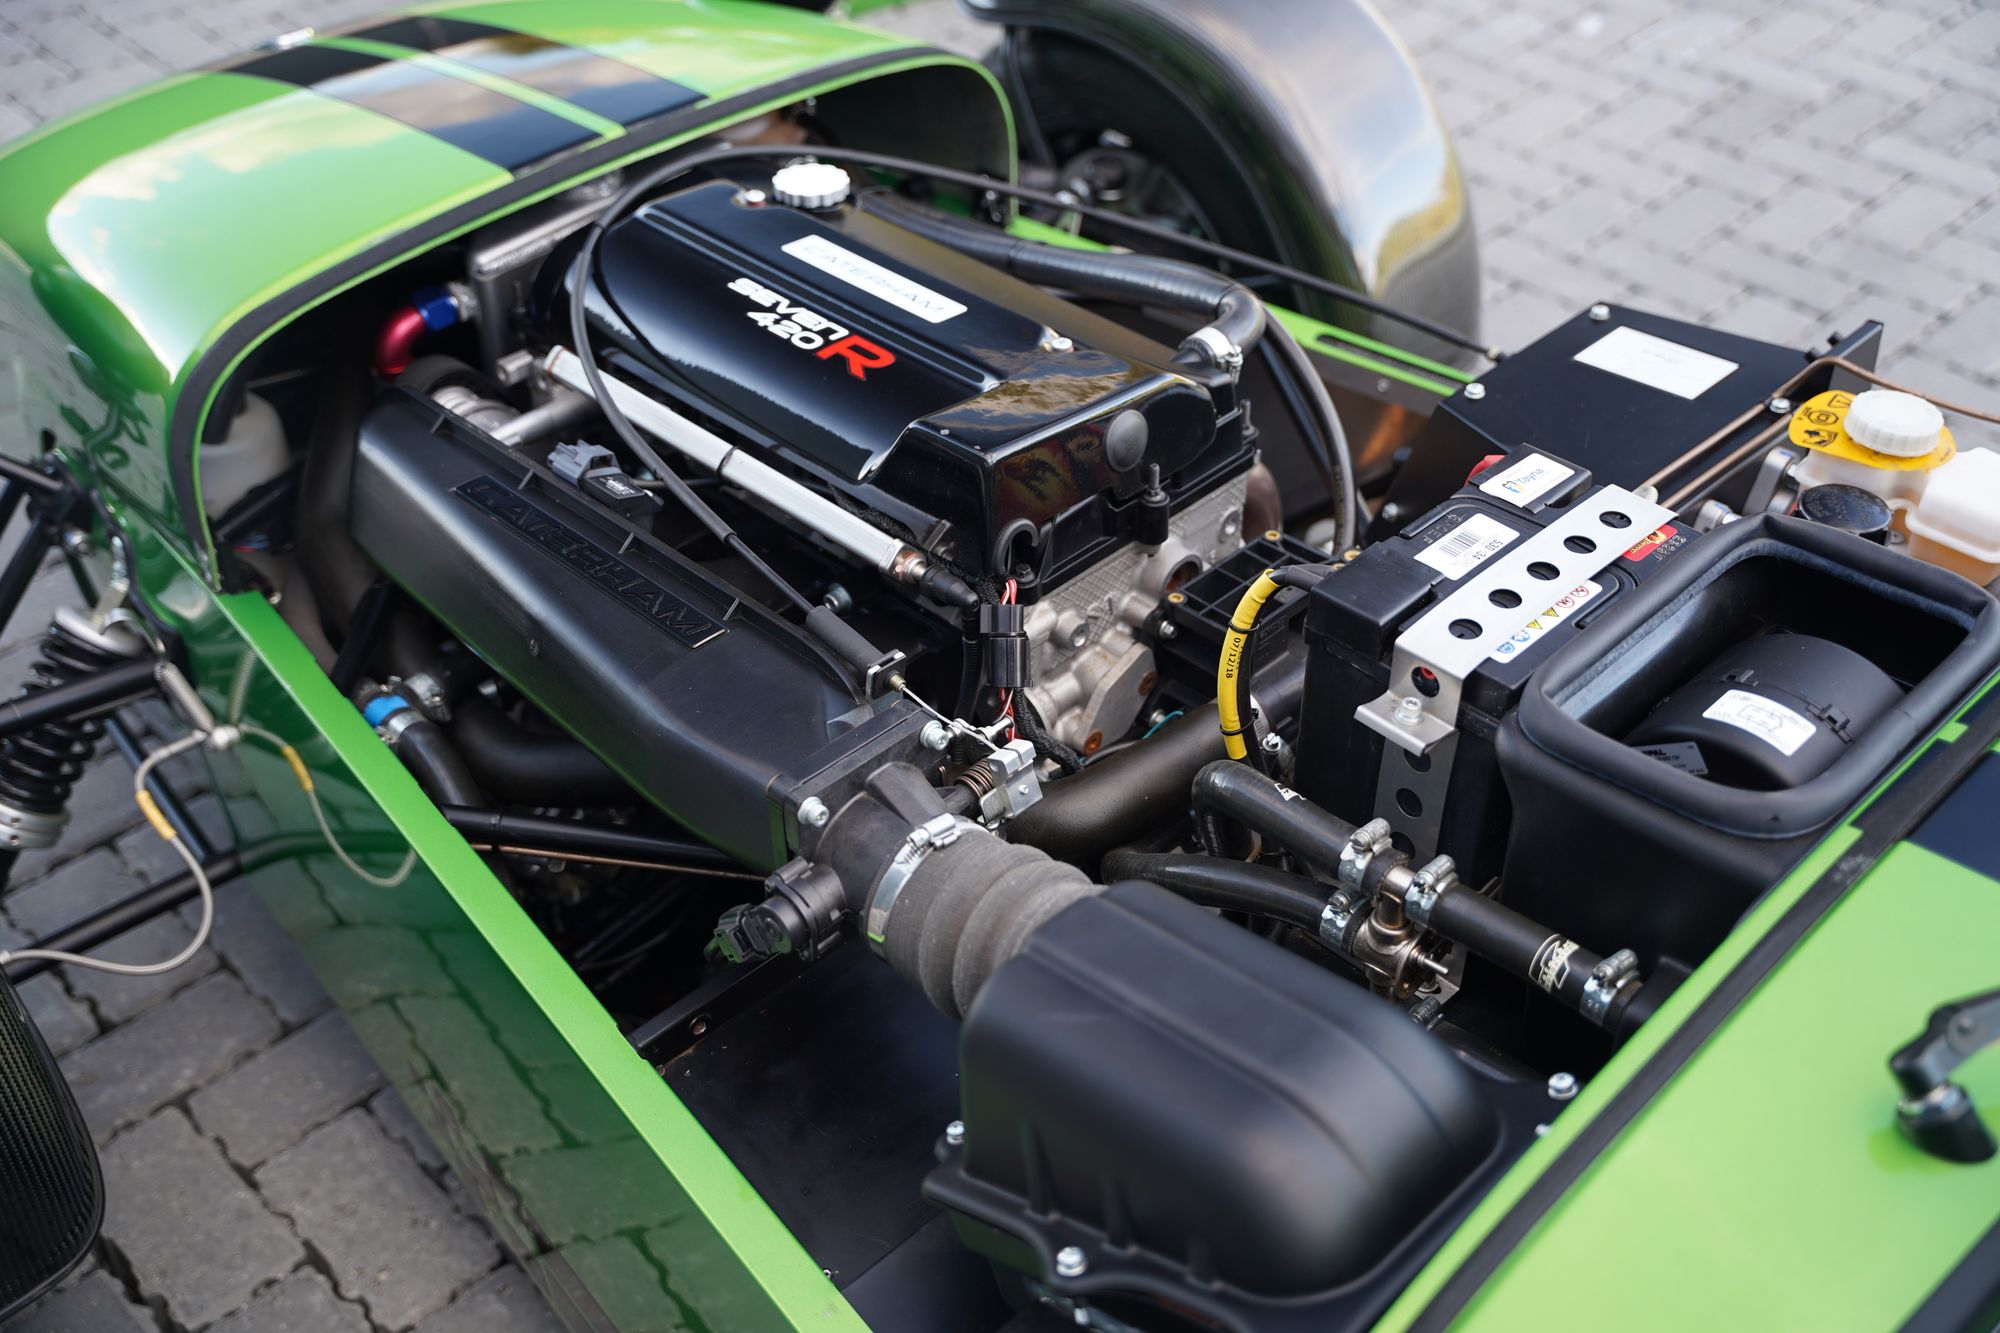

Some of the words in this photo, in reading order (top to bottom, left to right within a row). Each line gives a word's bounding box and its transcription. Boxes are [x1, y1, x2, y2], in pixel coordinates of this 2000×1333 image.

[803, 243, 945, 313] CATERHAM
[746, 311, 825, 350] 420
[816, 335, 896, 381] R
[1515, 468, 1544, 484] Tayna
[465, 483, 713, 634] CATERHAM
[1225, 637, 1241, 679] 07/12/18
